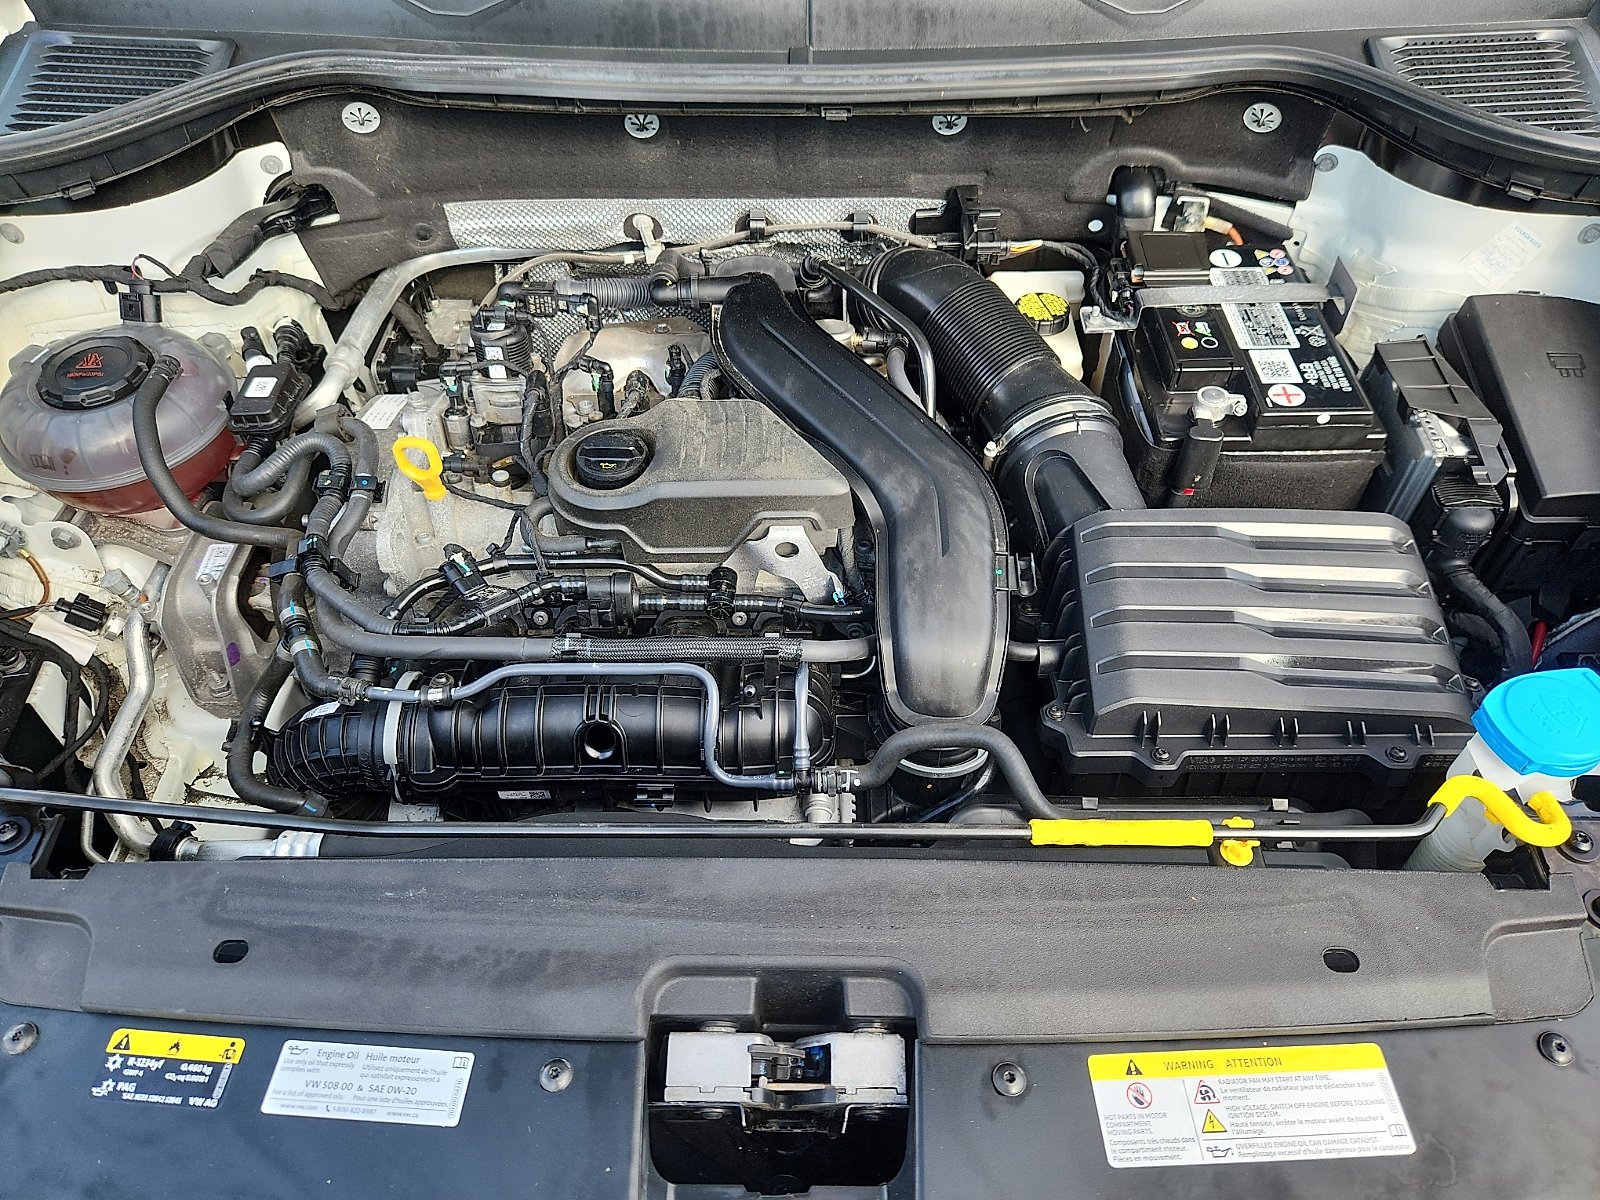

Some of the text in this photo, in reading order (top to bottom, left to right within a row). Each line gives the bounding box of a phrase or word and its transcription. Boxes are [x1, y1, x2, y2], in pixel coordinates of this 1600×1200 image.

[317, 1049, 359, 1060] Engine Oil
[366, 1052, 420, 1064] Huile moteur
[1164, 1057, 1283, 1070] WARNING ATTENTION
[116, 1082, 137, 1092] PAG
[305, 1080, 321, 1088] VW
[322, 1081, 340, 1090] 508
[341, 1082, 353, 1091] 00
[368, 1084, 385, 1093] SAE
[387, 1085, 417, 1095] 0W-20
